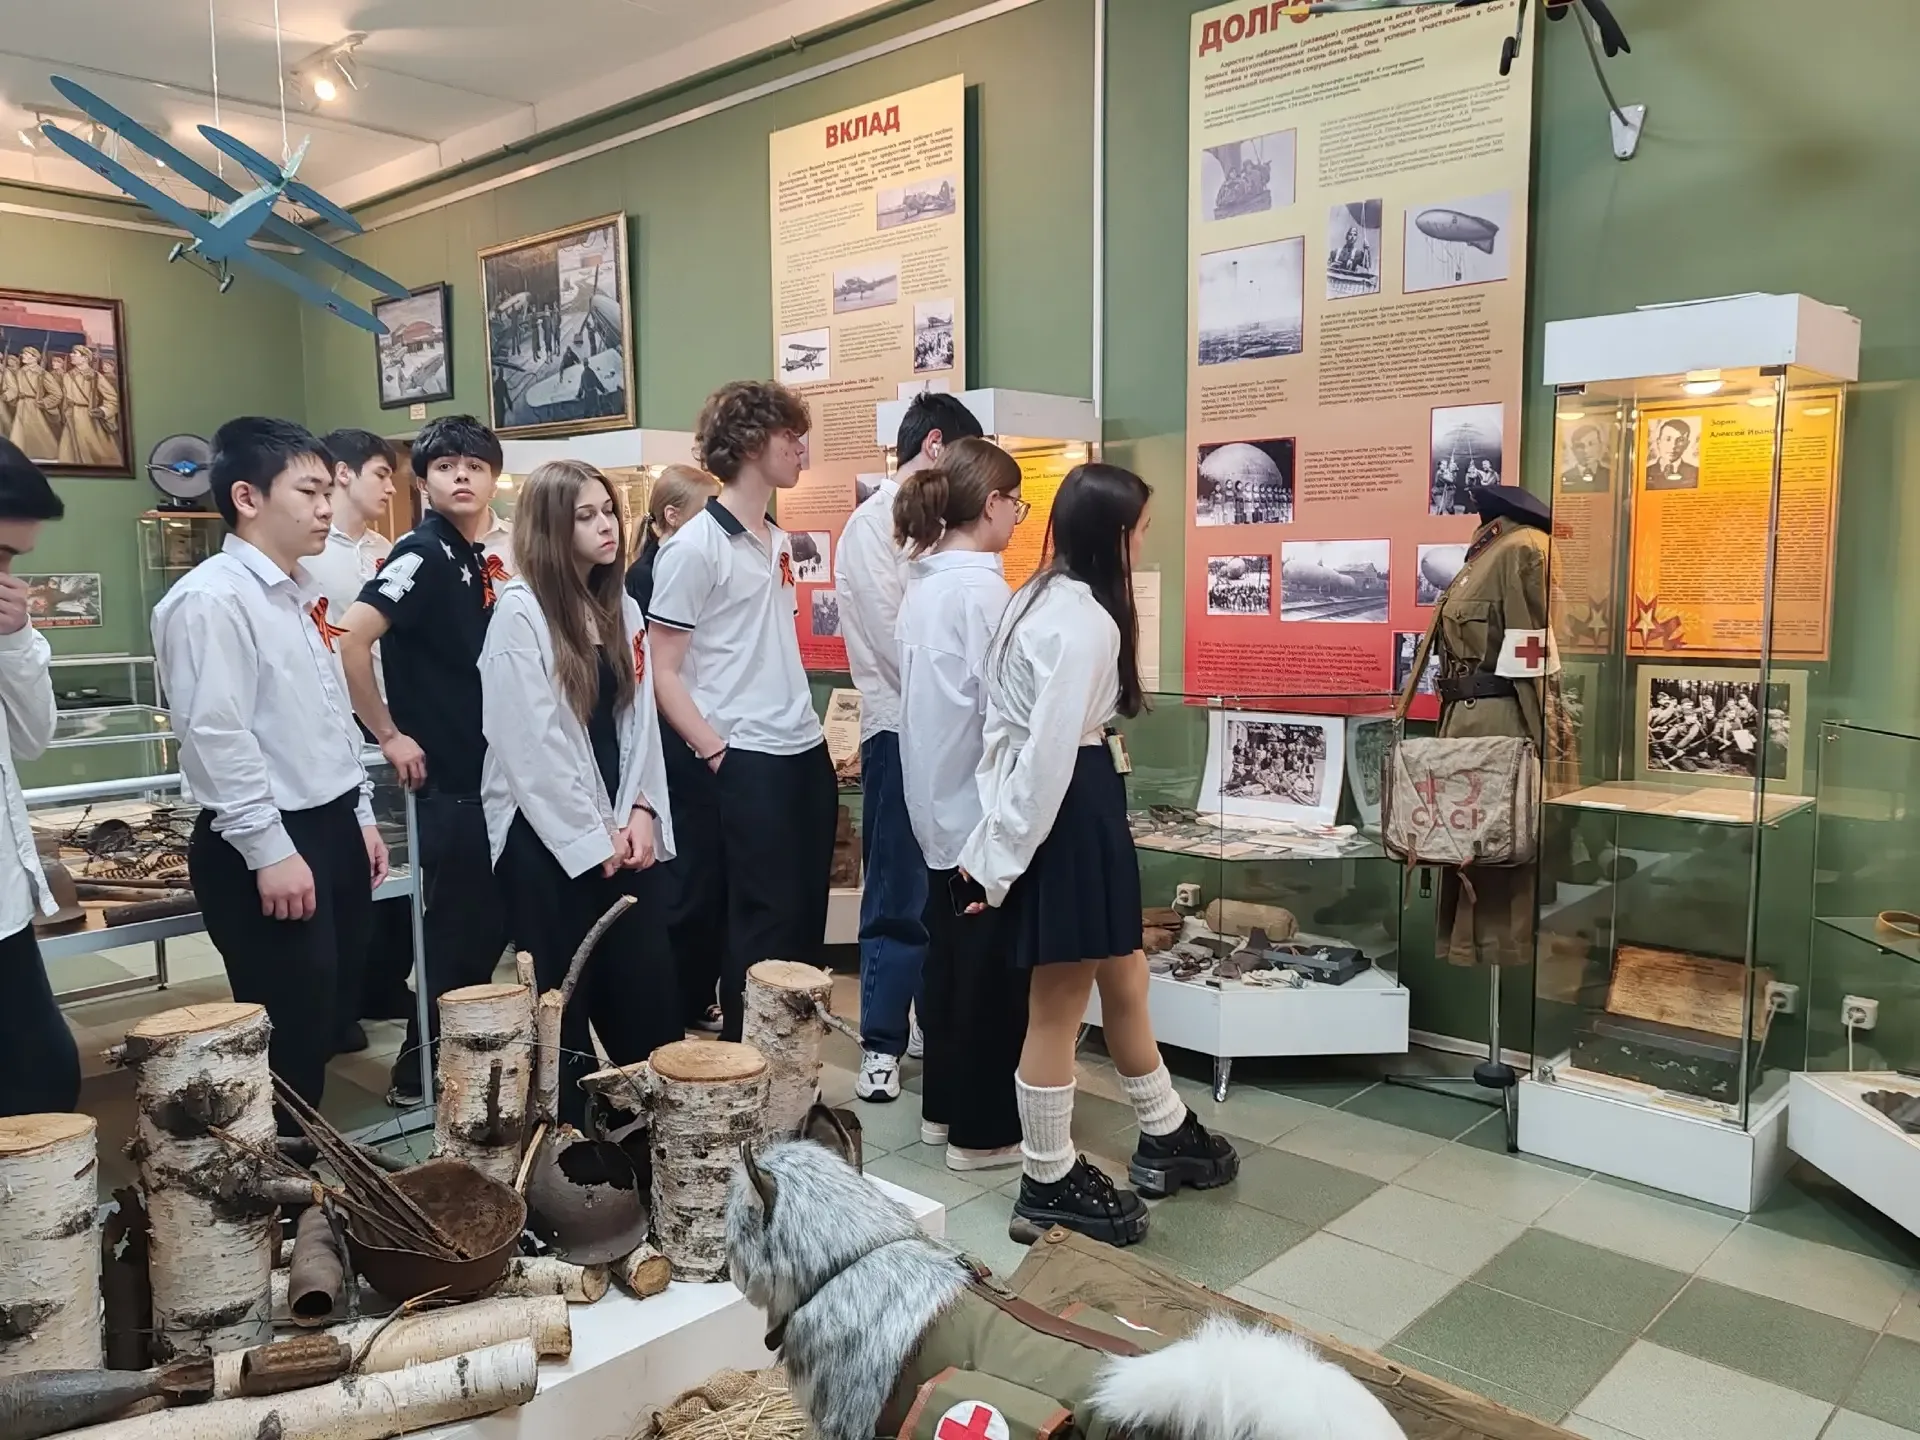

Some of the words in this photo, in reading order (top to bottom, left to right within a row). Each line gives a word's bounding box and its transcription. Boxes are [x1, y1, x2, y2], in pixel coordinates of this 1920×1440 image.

[1198, 0, 1323, 57] ДОЛГО
[825, 105, 900, 149] ВКЛАД
[1710, 419, 1737, 428] Зорин
[1747, 428, 1794, 437] Иваноич
[376, 552, 424, 603] 4
[1411, 806, 1486, 831] СССР
